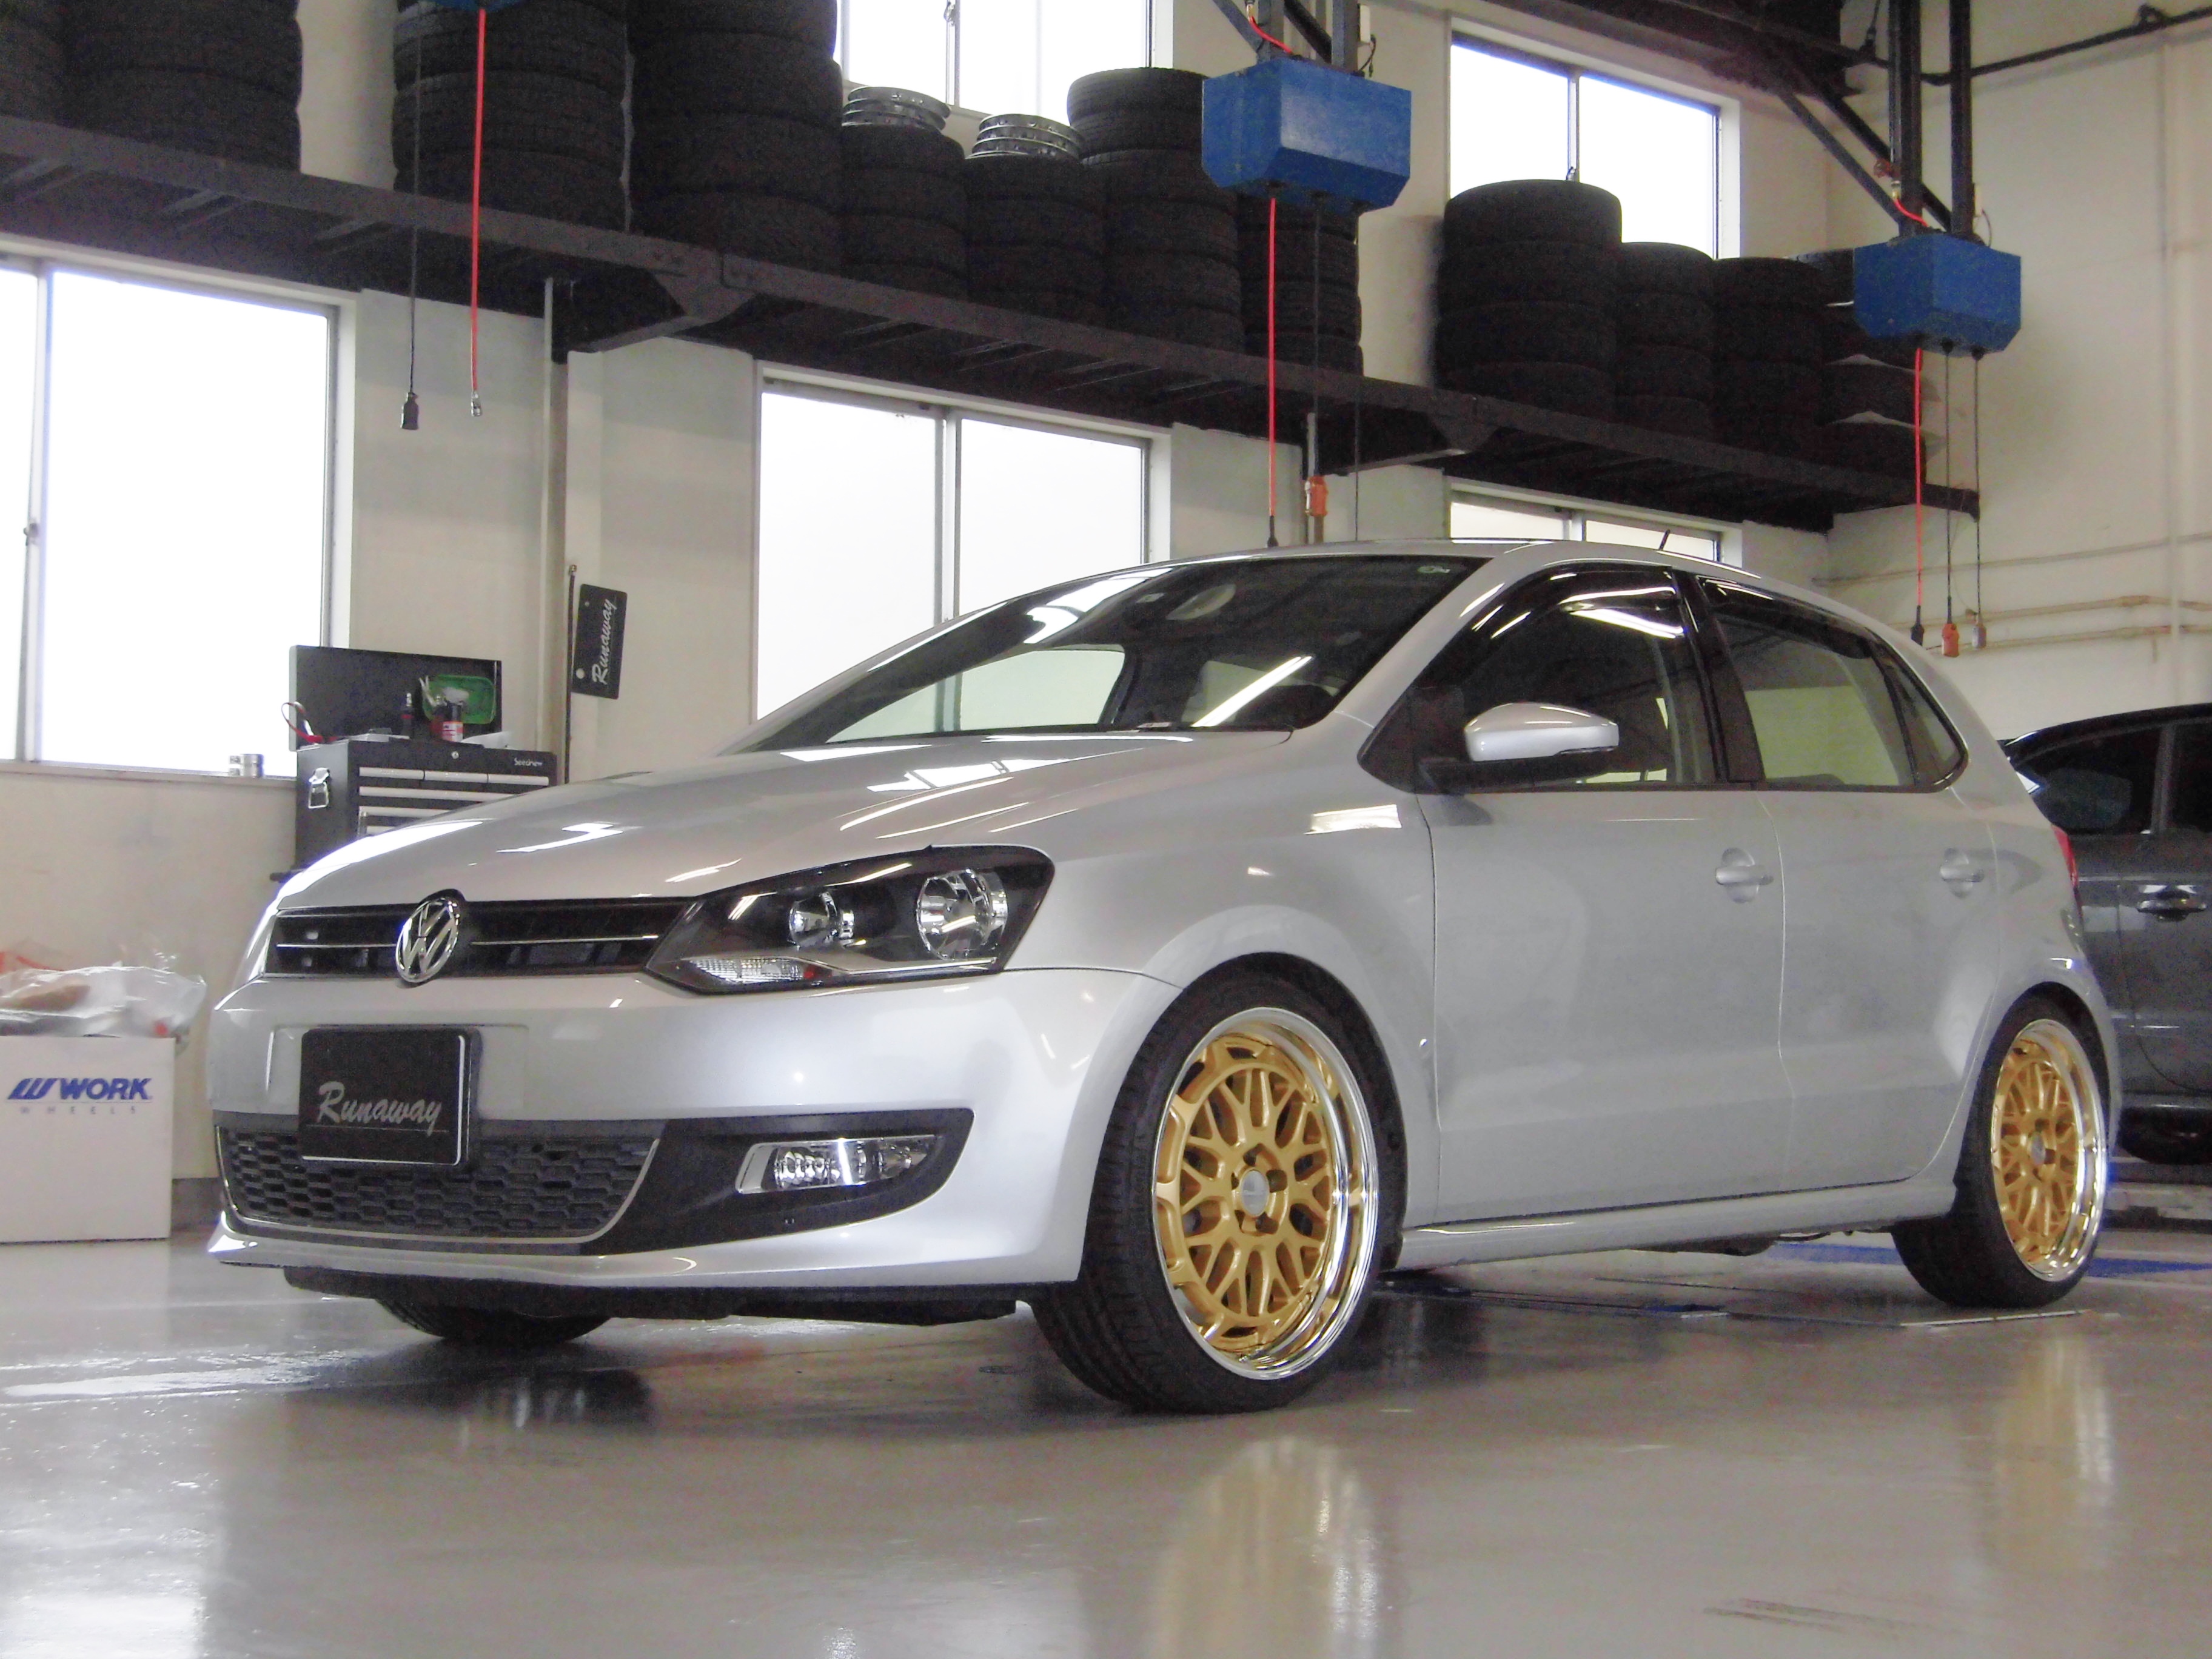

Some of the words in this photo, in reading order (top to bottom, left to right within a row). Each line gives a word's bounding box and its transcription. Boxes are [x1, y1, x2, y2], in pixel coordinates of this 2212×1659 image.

[591, 598, 617, 685] Runaway
[59, 1078, 153, 1100] WORK
[20, 1105, 136, 1114] WHEELS
[317, 1081, 442, 1136] Runaway
